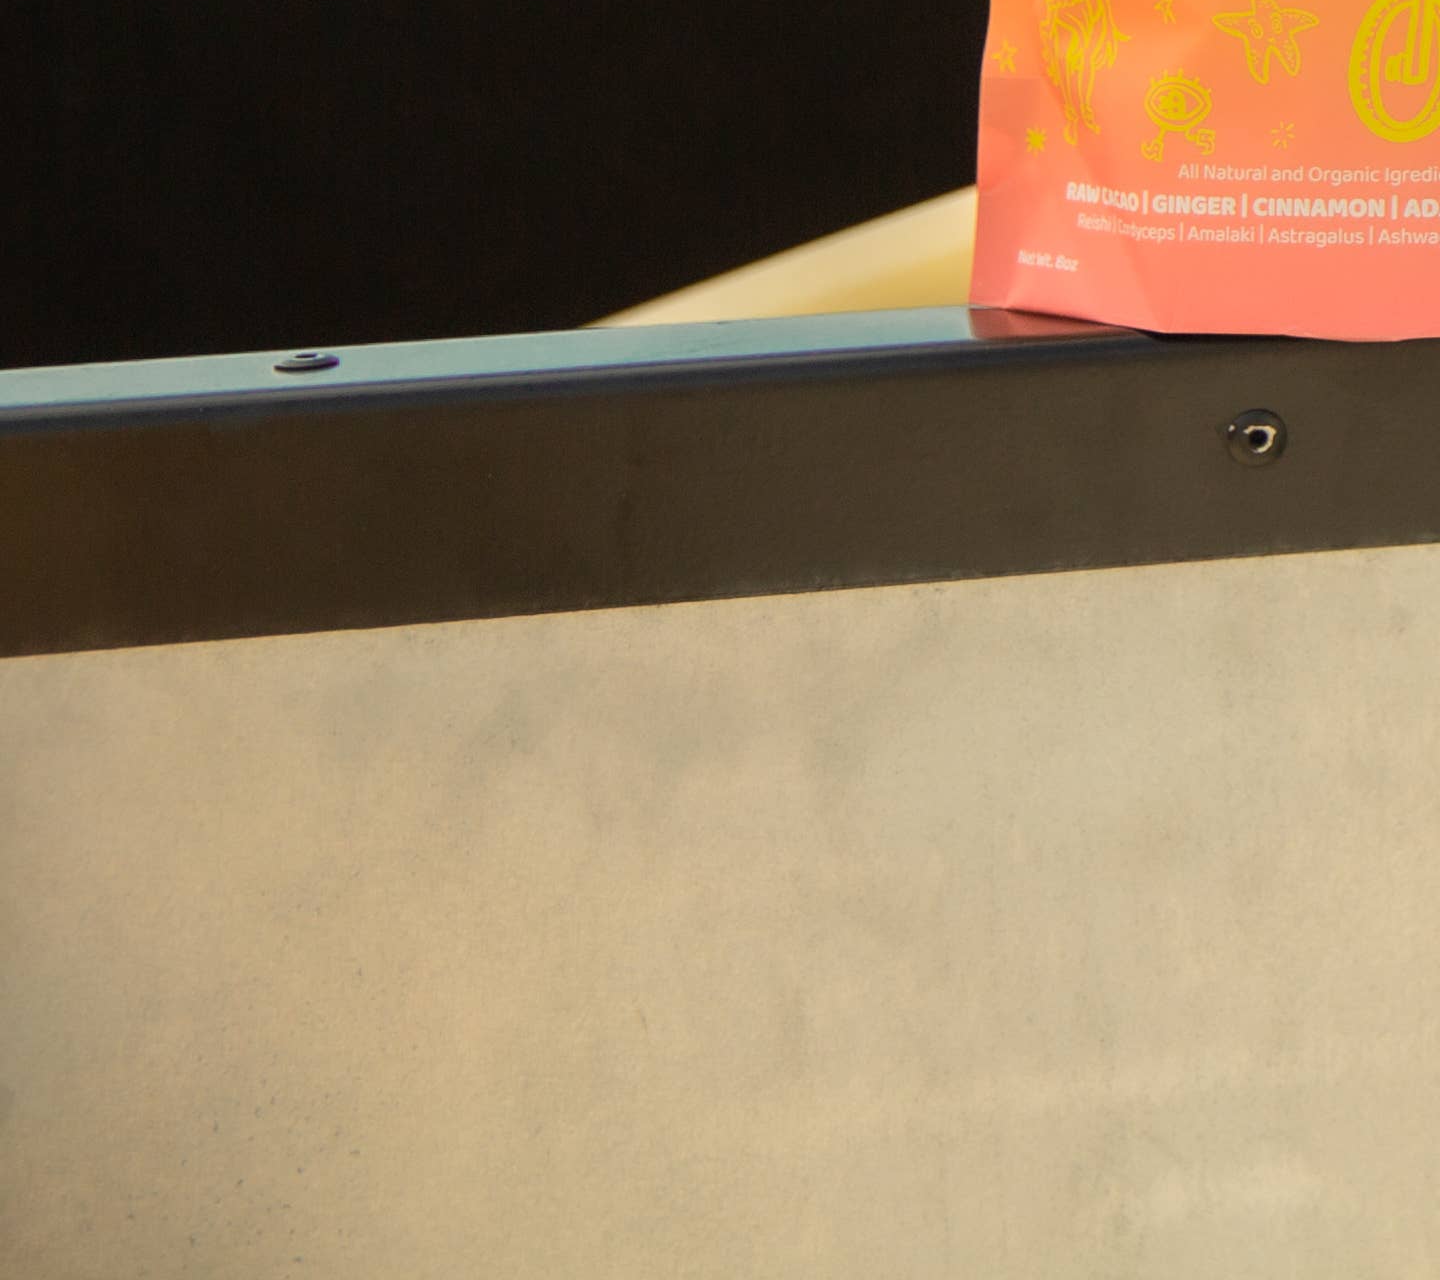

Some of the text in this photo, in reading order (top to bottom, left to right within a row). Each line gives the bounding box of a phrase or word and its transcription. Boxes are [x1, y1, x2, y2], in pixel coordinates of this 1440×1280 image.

[1178, 163, 1200, 180] All
[1203, 163, 1268, 182] Natural
[1271, 165, 1305, 183] and
[1308, 165, 1383, 187] Organic
[1065, 181, 1100, 205] RAW
[1152, 194, 1237, 217] GINGER
[1253, 196, 1386, 219] CINNAMON
[1187, 225, 1256, 243] Amalaki
[1267, 226, 1365, 249] Astragalus
